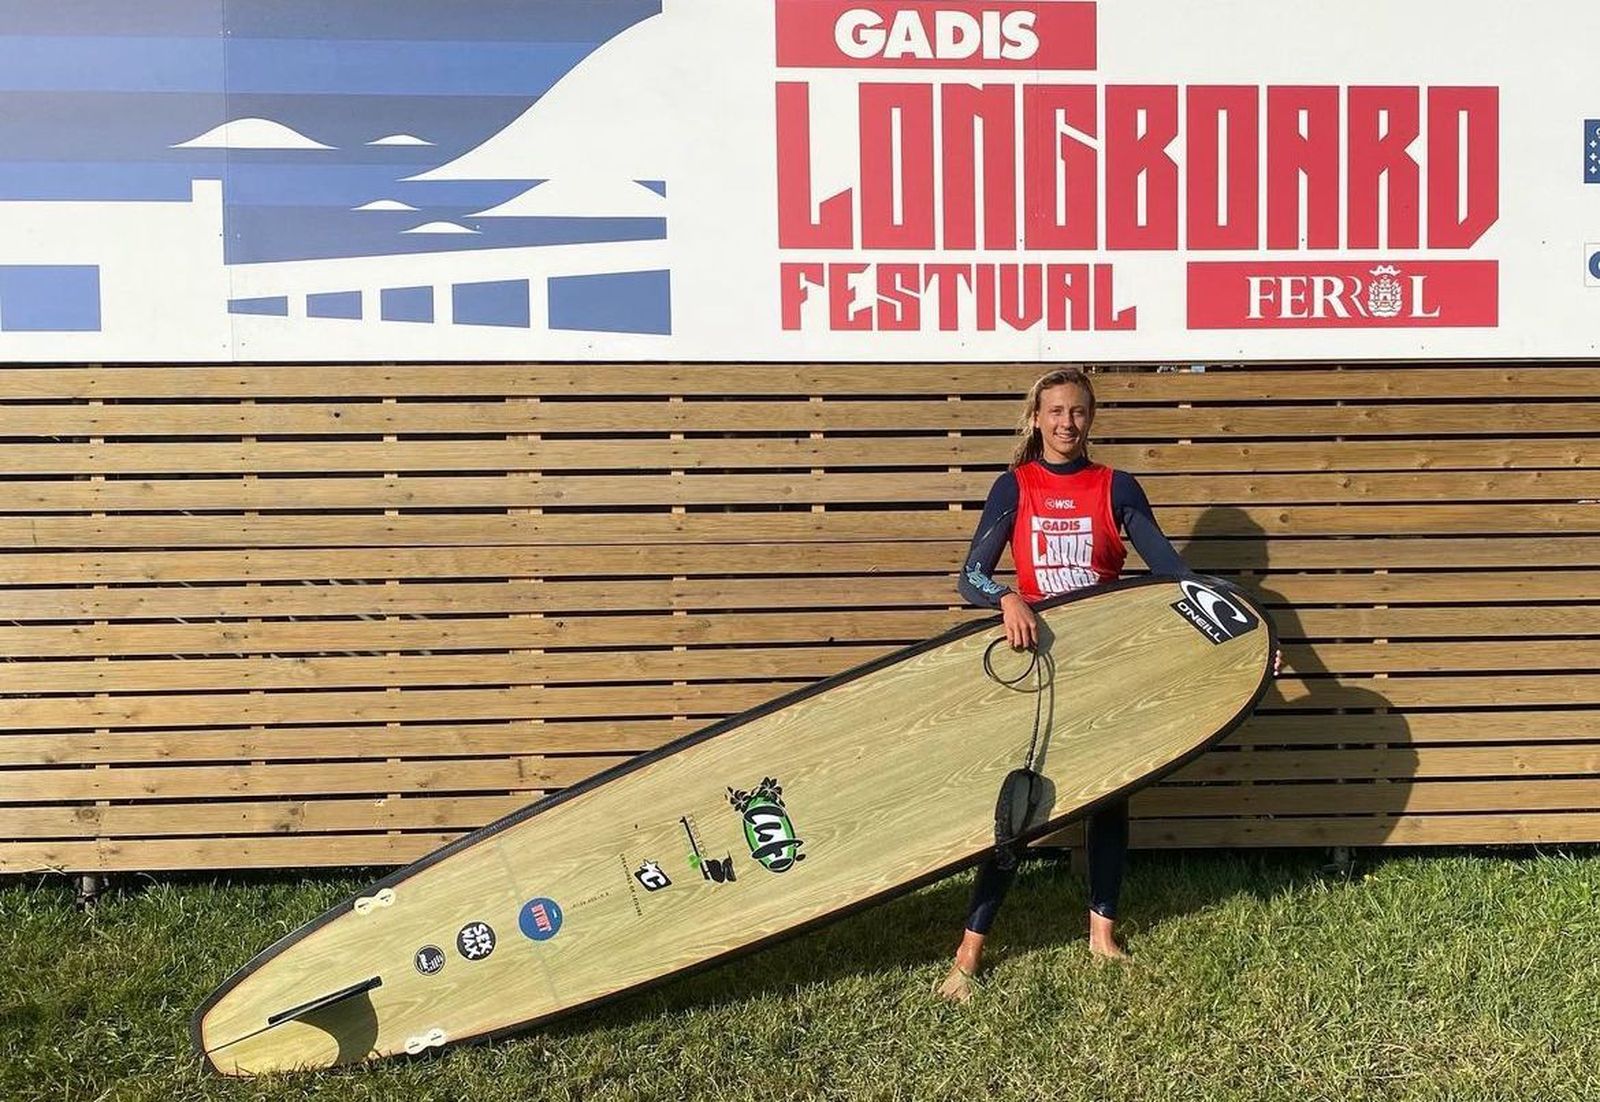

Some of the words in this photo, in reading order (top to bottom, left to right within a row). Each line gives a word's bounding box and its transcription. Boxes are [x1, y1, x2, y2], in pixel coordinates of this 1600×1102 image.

[834, 8, 1039, 60] GADIS
[775, 81, 1500, 251] LONGBOARD
[780, 262, 1137, 332] FESTIVAL
[1055, 499, 1076, 509] WSL
[1042, 520, 1081, 531] GADIS
[1031, 532, 1094, 567] LONG
[461, 926, 481, 959] WAX
